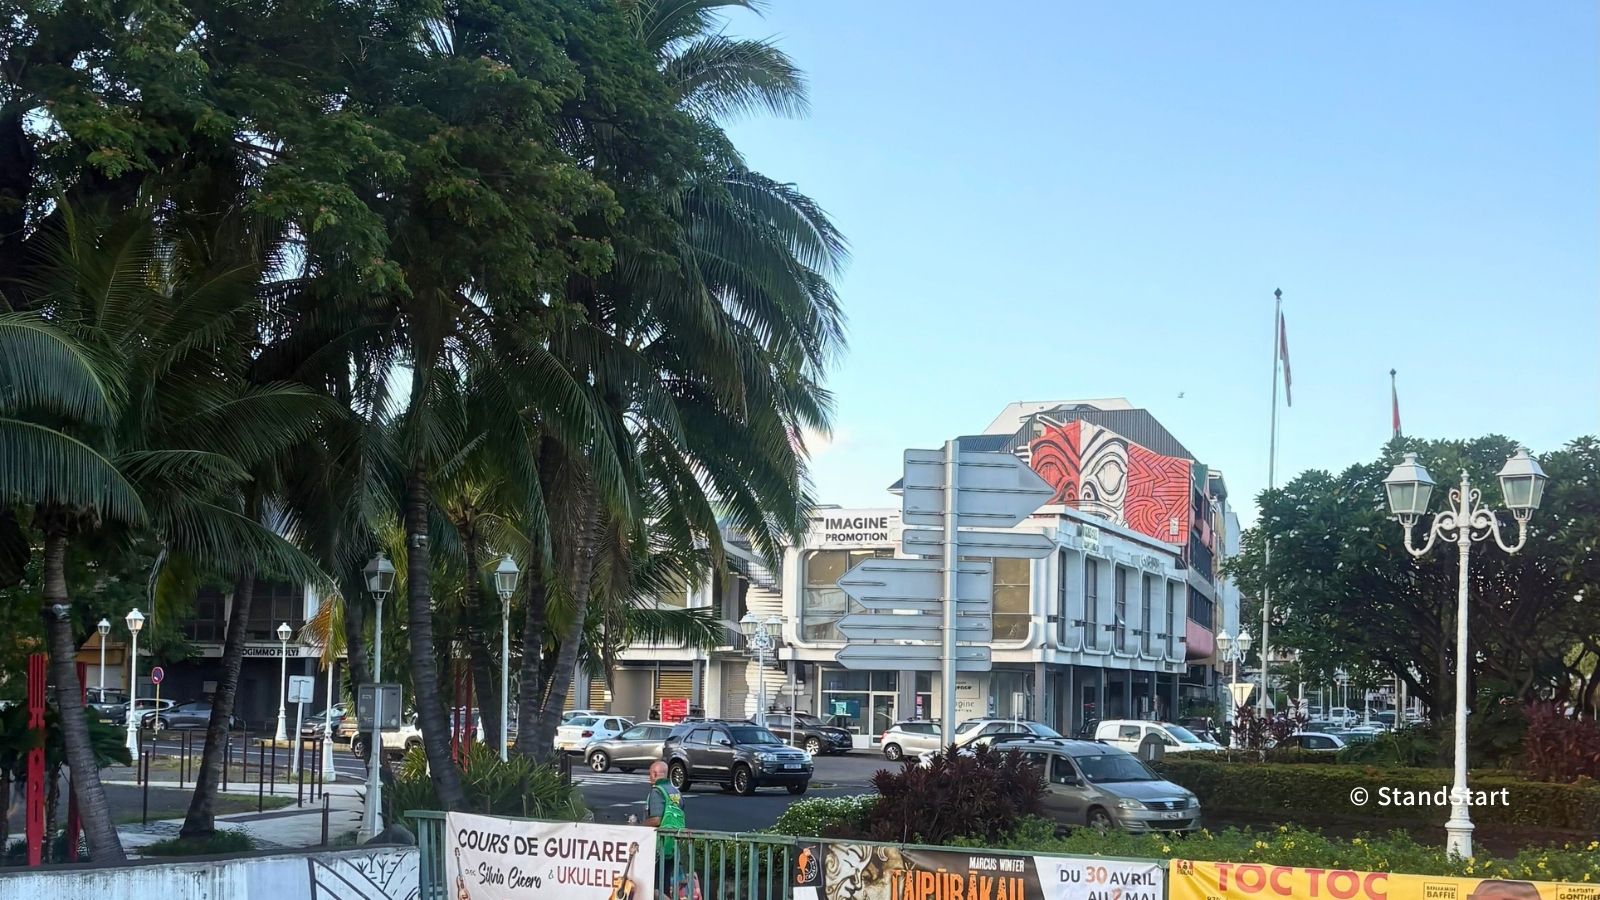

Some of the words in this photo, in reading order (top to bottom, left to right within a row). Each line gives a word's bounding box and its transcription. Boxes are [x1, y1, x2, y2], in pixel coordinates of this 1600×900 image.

[825, 517, 888, 530] IMAGINE
[825, 532, 888, 542] PROMOTION
[458, 828, 510, 854] COURS
[514, 835, 539, 856] DE
[543, 837, 628, 863] GUITARE
[969, 856, 997, 870] MARCUS
[999, 859, 1025, 872] WINTER
[478, 861, 504, 886] Silvio
[508, 866, 542, 889] Cicero
[557, 865, 620, 888] UKULELE
[1060, 869, 1081, 883] DU
[1086, 866, 1107, 884] 30
[1110, 871, 1156, 886] AVRIL
[1214, 862, 1293, 896] TOC
[1305, 868, 1388, 900] TOC
[1088, 891, 1108, 900] AU
[1125, 892, 1156, 900] MAI
[1426, 891, 1456, 899] BAFFIE
